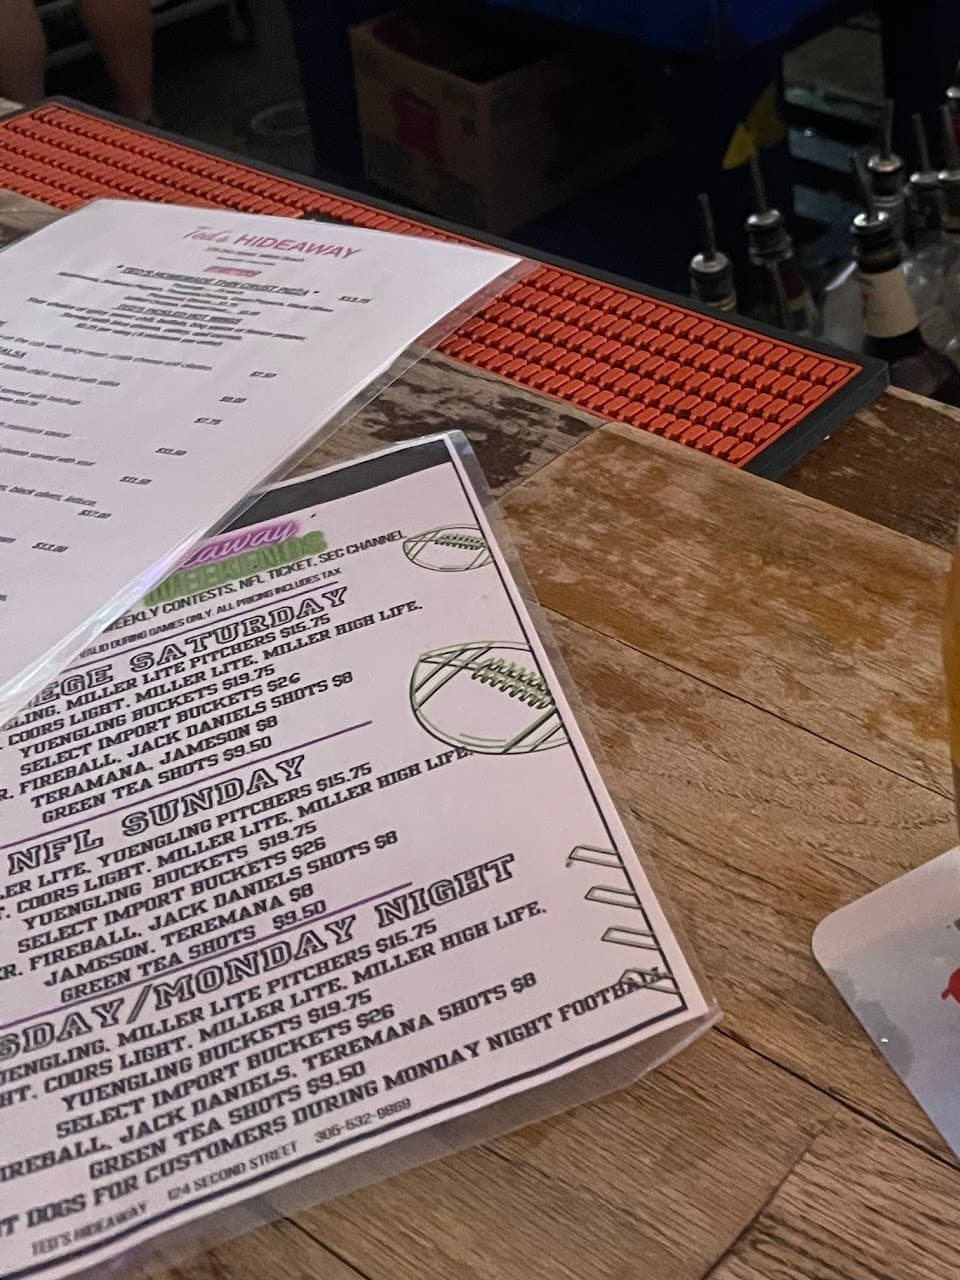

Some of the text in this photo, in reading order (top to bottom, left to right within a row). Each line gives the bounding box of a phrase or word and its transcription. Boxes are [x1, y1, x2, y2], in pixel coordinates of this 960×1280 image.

[232, 234, 362, 259] HIDEAWAY
[184, 523, 294, 568] away
[239, 573, 266, 591] NFL
[318, 548, 346, 565] SEC
[346, 530, 407, 555] CHANNEL
[110, 630, 149, 651] DURING
[149, 618, 185, 640] GAMES
[216, 600, 236, 615] ALL
[236, 588, 274, 610] PRICING
[273, 575, 320, 599] INCLUDES
[319, 567, 342, 584] TAX
[130, 586, 349, 673] SATURDAY
[8, 718, 64, 746] COORS
[134, 671, 207, 704] MILLER
[262, 628, 332, 659] MILLER
[335, 613, 375, 637] HIGH
[18, 713, 127, 760] YUENGLING
[131, 683, 218, 721] BUCKETS
[221, 664, 275, 692] $19.75
[66, 678, 137, 711] MILLER
[142, 661, 186, 686] LITE
[189, 629, 276, 667] PITCHERS
[279, 613, 331, 639] $15.75
[20, 742, 92, 777] SELECT
[98, 716, 171, 751] IMPORT
[177, 685, 263, 724] BUCKETS
[267, 671, 301, 694] $26
[126, 731, 181, 759] JACK
[186, 700, 267, 738] DANIELS
[270, 679, 329, 709] SHOTS
[332, 671, 354, 688] $8
[158, 724, 250, 766] JAMESON
[256, 715, 279, 733] $8
[8, 754, 305, 877] NFL SUNDAY
[42, 792, 106, 824] GREEN
[111, 778, 153, 801] TEA
[157, 754, 219, 785] SHOTS
[222, 735, 273, 762] $9.50
[97, 818, 212, 868] YUENGLING
[215, 784, 312, 828] PITCHERS
[315, 762, 373, 792] $15.75
[16, 884, 79, 915] COORS
[156, 828, 237, 869] MILLER
[296, 781, 374, 818] MILLER
[376, 763, 423, 789] HIGH
[22, 882, 142, 931] YUENGLING
[153, 845, 248, 889] BUCKETS
[258, 820, 318, 851] $19.75
[148, 899, 208, 932] JACK
[213, 866, 302, 909] DANIELS
[306, 841, 371, 875] SHOTS
[374, 830, 398, 851] $8
[17, 837, 327, 954] SELECT IMPORT BUCKETS $26
[160, 895, 285, 948] TEREMANA
[289, 882, 314, 903] $8
[374, 853, 515, 929] NIGHT
[60, 967, 132, 1003] GREEN
[137, 951, 184, 977] TEA
[188, 924, 256, 960] SHOTS
[272, 900, 327, 930] $9.50
[117, 1007, 205, 1047] MILLER
[210, 985, 262, 1017] LITE
[266, 944, 372, 996] PITCHERS
[375, 918, 437, 953] $15.75
[44, 1058, 113, 1094] COORS
[198, 998, 285, 1043] MILLER
[352, 942, 436, 985] MILLER
[440, 920, 490, 952] HIGH
[62, 1056, 193, 1112] YUENGLING
[198, 1015, 302, 1068] BUCKETS
[307, 988, 372, 1024] $19.75
[119, 1106, 187, 1144] JACK
[302, 1014, 434, 1071] TEREMANA
[437, 983, 508, 1022] SHOTS
[510, 972, 538, 994] $8
[25, 1193, 87, 1228] DOGS
[93, 1175, 139, 1207] FOR
[145, 1116, 287, 1185] CUSTOMERS
[292, 1080, 378, 1126] DURING
[381, 1040, 481, 1091] MONDAY
[485, 1012, 553, 1052] NIGHT
[56, 1097, 145, 1139] SELECT
[152, 1062, 240, 1109] IMPORT
[247, 1019, 352, 1070] BUCKETS
[356, 1003, 395, 1029] $26
[89, 1060, 366, 1180] GREEN TEA SHOTS $9.50
[73, 1200, 148, 1243] HIDEAWAY
[193, 1162, 247, 1192] SECOND
[250, 1140, 299, 1171] STREET
